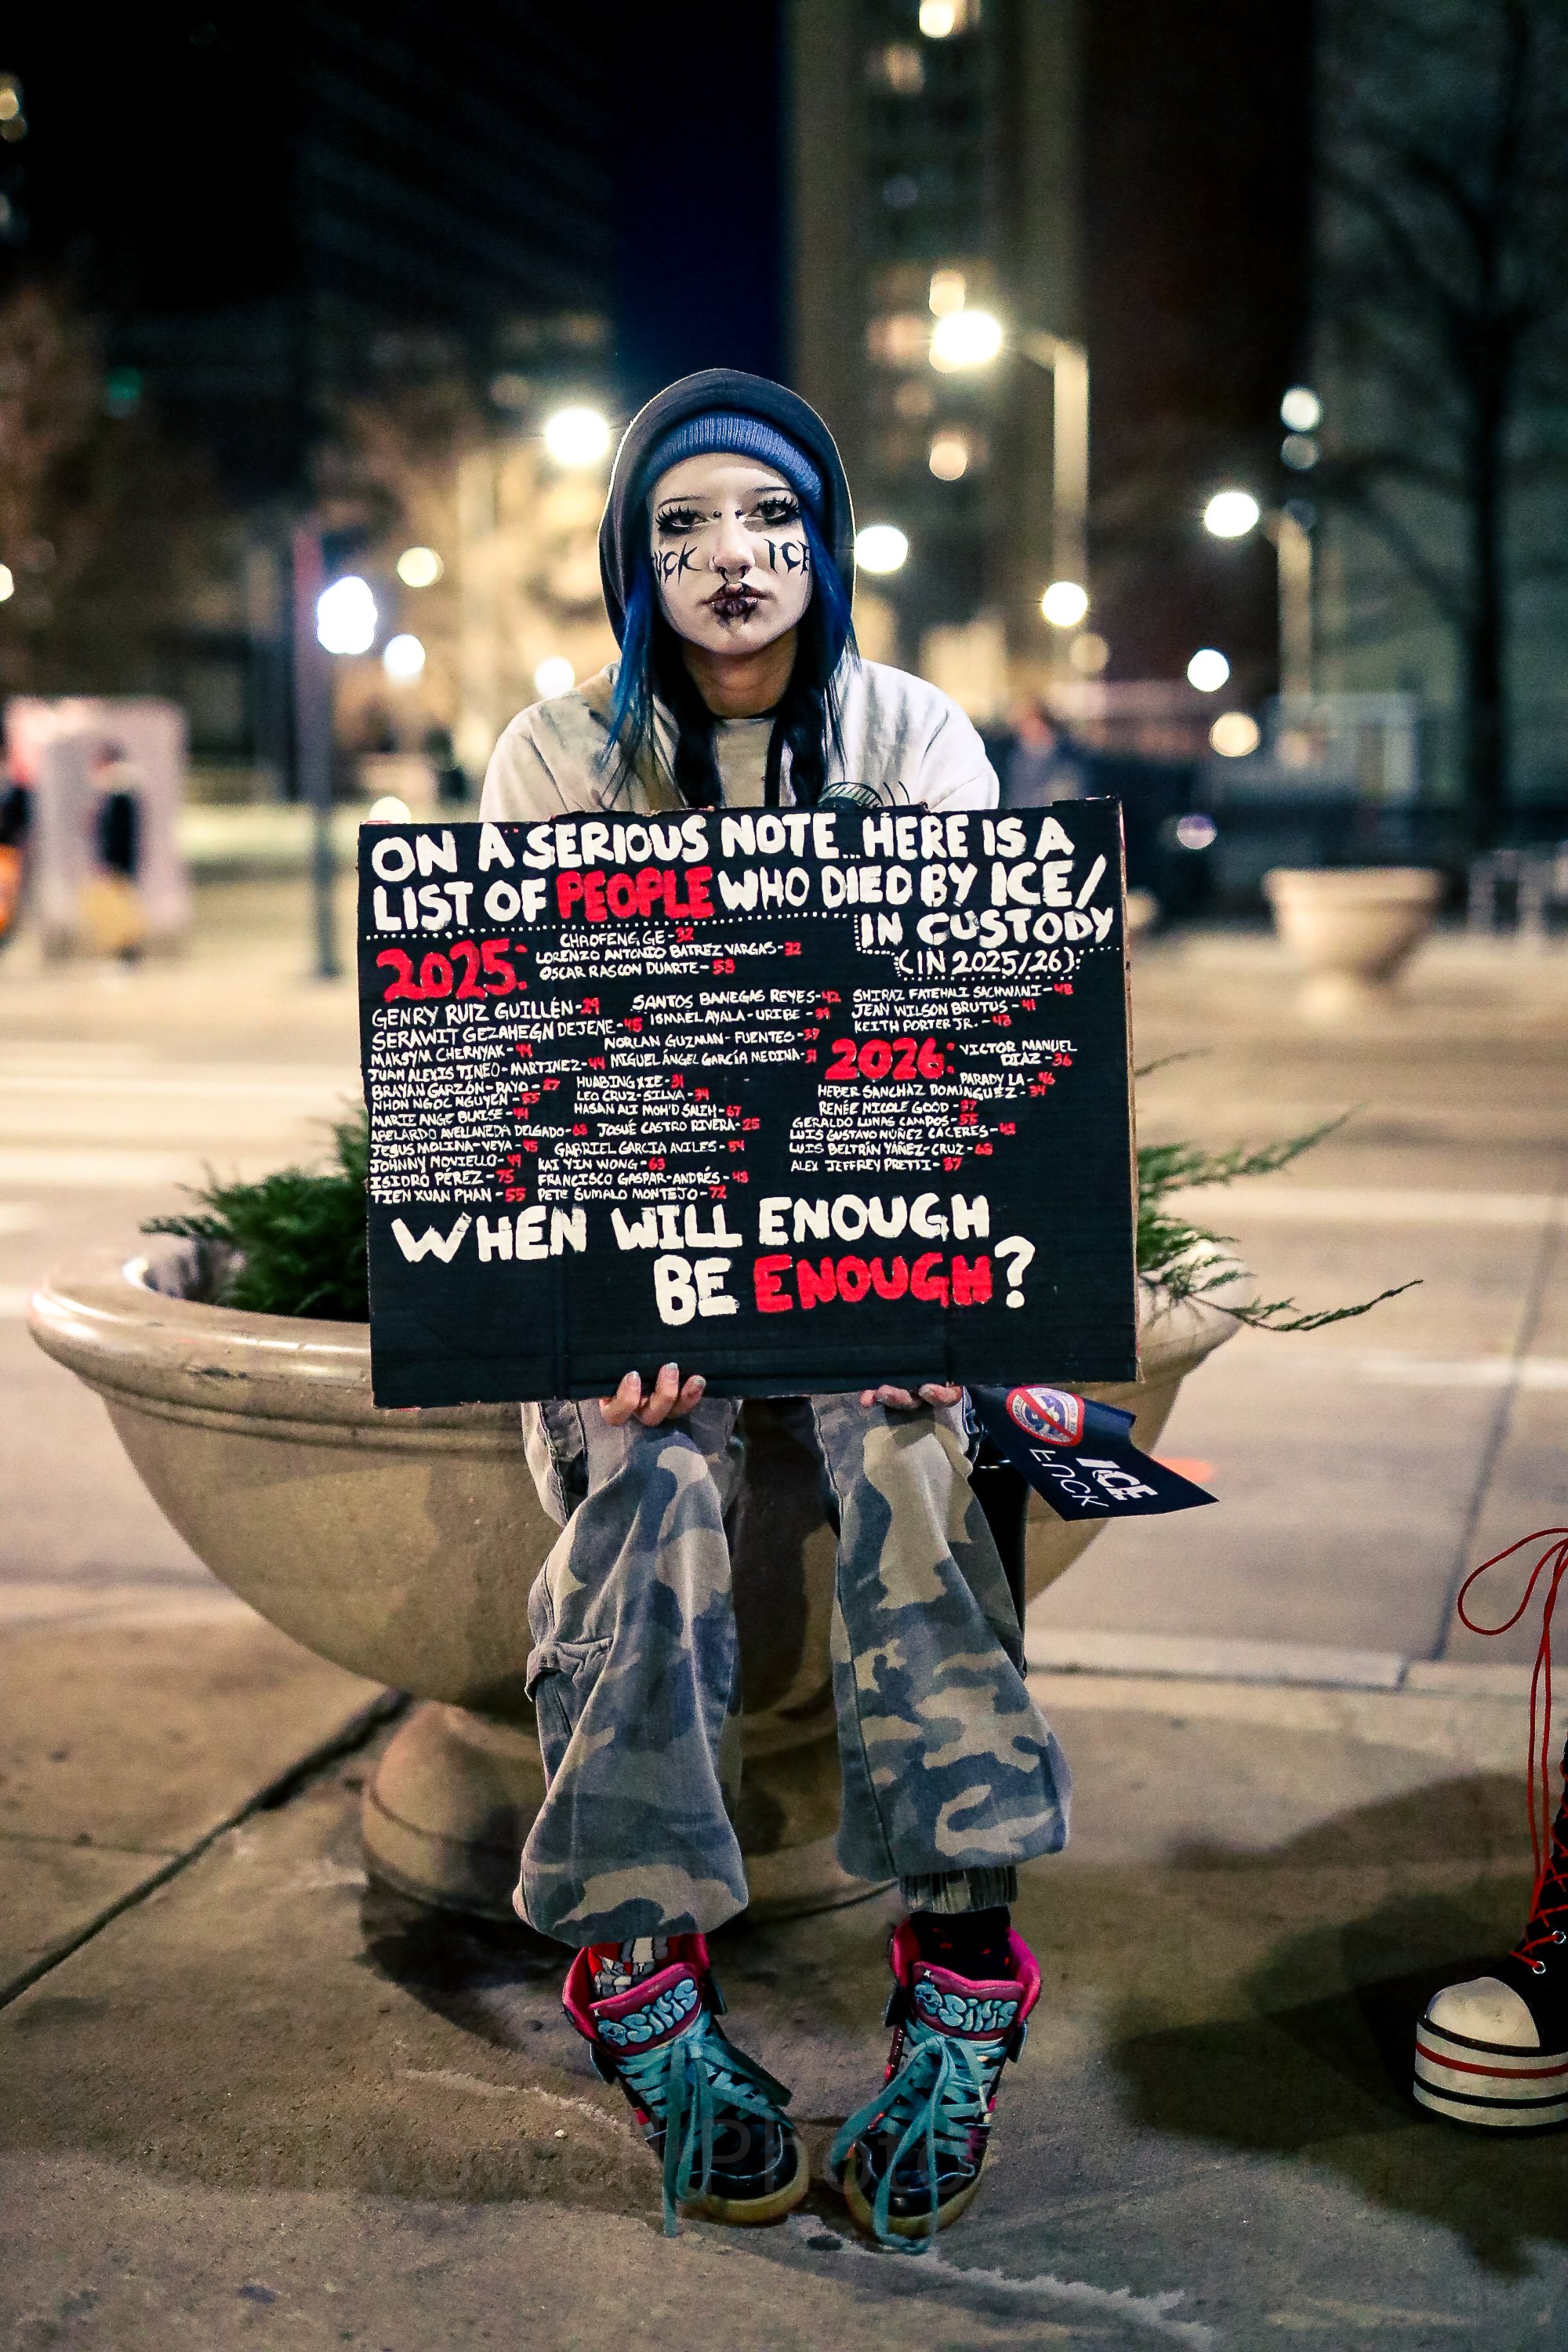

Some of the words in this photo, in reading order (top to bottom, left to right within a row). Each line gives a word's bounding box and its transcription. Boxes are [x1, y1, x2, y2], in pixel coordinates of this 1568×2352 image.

[372, 830, 457, 881] ON
[478, 822, 515, 872] A
[523, 815, 709, 869] SERIOUS
[862, 812, 968, 860] HERE
[982, 817, 1026, 858] IS
[1033, 817, 1075, 860] A
[373, 881, 474, 931] LIST
[485, 878, 546, 922] OF
[556, 866, 715, 924] PEOPLE
[718, 866, 809, 911] WHO
[822, 866, 913, 909] DIED
[920, 862, 978, 907] BY
[861, 912, 903, 948] IN
[916, 907, 1113, 949] CUSTODY
[560, 931, 640, 948] CHAOFENG
[535, 949, 600, 964] LORENZO
[604, 946, 666, 961] ANTONIO
[897, 947, 946, 975] (IN
[952, 947, 1075, 976] 2025/26)
[539, 966, 586, 981] OSCAR
[633, 995, 693, 1010] SANTOS
[699, 989, 765, 1005] BANEGAS
[853, 989, 905, 1002] SHIRAZ
[372, 1006, 438, 1029] GENRY
[445, 1004, 489, 1025] RUIZ
[651, 1011, 701, 1025] ISMAEL
[851, 1003, 889, 1018] JEAN
[894, 1003, 948, 1018] WILSON
[855, 1020, 899, 1033] KEITH
[903, 1018, 951, 1032] PORTER
[953, 1018, 978, 1030] JR.
[372, 1029, 459, 1051] SERAWIT
[463, 1022, 554, 1043] GEZAHEGN
[604, 1036, 660, 1051] NORLAN
[960, 1040, 1016, 1055] VICTOR
[1022, 1040, 1077, 1052] MANUEL
[372, 1050, 433, 1068] MAKSYM
[611, 1053, 661, 1068] MIGUEL
[662, 1049, 699, 1065] ÁNGEL
[702, 1050, 747, 1066] GARCÍA
[368, 1069, 405, 1082] JUAN
[408, 1066, 454, 1082] ALEXIS
[960, 1073, 1004, 1090] PARADY
[577, 1076, 635, 1089] HUABING
[372, 1083, 426, 1100] BRAYAN
[577, 1091, 599, 1101] LEO
[818, 1084, 861, 1098] HEBER
[372, 1100, 409, 1114] NHON
[413, 1098, 452, 1109] NGOC
[575, 1102, 615, 1115] HASAN
[618, 1104, 638, 1115] ALI
[819, 1100, 859, 1116] RENÉE
[862, 1101, 909, 1115] NICOLE
[372, 1114, 416, 1127] MARIE
[419, 1113, 455, 1126] ANGE
[793, 1116, 853, 1128] GERALDO
[857, 1116, 895, 1127] LUNAS
[372, 1128, 437, 1142] ABELARDO
[441, 1124, 511, 1139] AVELLANEDA
[597, 1119, 637, 1137] JOSUÉ
[641, 1121, 687, 1134] CASTRO
[790, 1129, 823, 1140] LUIS
[826, 1129, 877, 1142] GUSTAVO
[880, 1127, 922, 1140] NÚÑEZ
[371, 1143, 415, 1158] JESUS
[554, 1142, 616, 1157] GABRIEL
[789, 1142, 824, 1154] LUIS
[828, 1142, 880, 1156] BELTRÁN
[370, 1156, 426, 1174] JOHNNY
[539, 1158, 559, 1172] KAI
[563, 1158, 592, 1170] YIN
[791, 1160, 818, 1171] ALEX
[825, 1159, 880, 1172] JEFFREY
[370, 1174, 430, 1189] ISIDRO
[538, 1172, 612, 1187] FRANCISCO
[371, 1189, 411, 1204] TIEN
[414, 1189, 450, 1203] XUAN
[538, 1188, 568, 1202] PETE
[575, 1188, 627, 1201] SUMALO
[391, 1205, 586, 1263] WHEN
[611, 1200, 742, 1250] WILL
[759, 1192, 989, 1245] ENOUGH
[654, 1255, 739, 1325] BE
